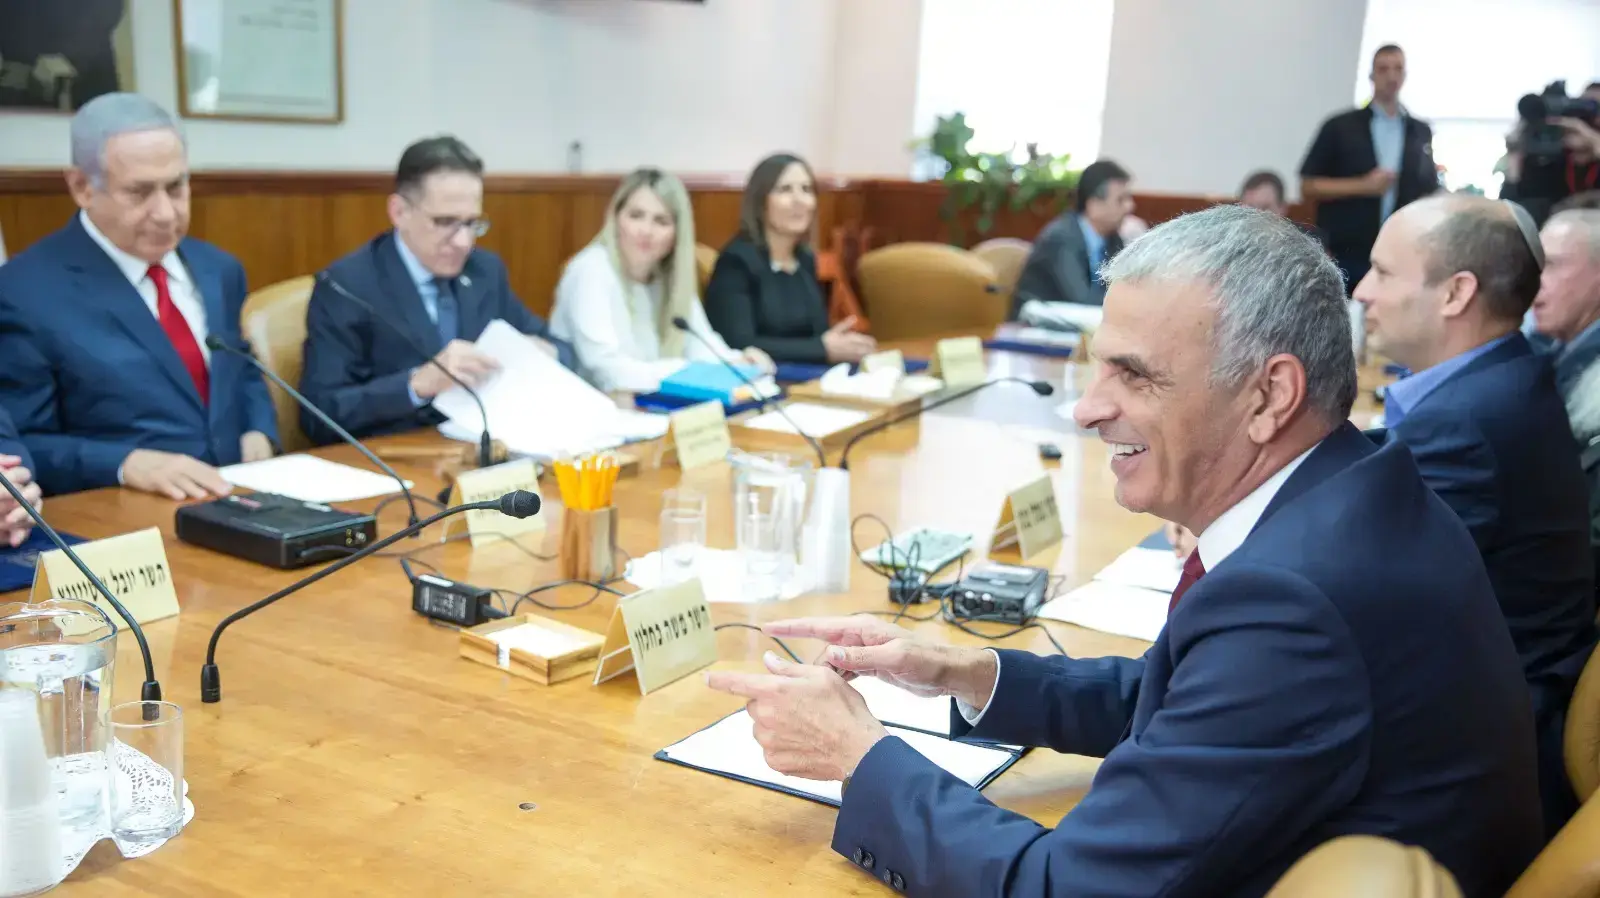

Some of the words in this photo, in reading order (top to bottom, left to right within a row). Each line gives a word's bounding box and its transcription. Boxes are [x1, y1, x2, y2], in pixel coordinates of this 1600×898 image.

[110, 568, 136, 595] יובל
[139, 563, 166, 587] השר
[663, 613, 688, 642] משה
[687, 604, 710, 631] השר
[634, 621, 663, 660] כחלון
